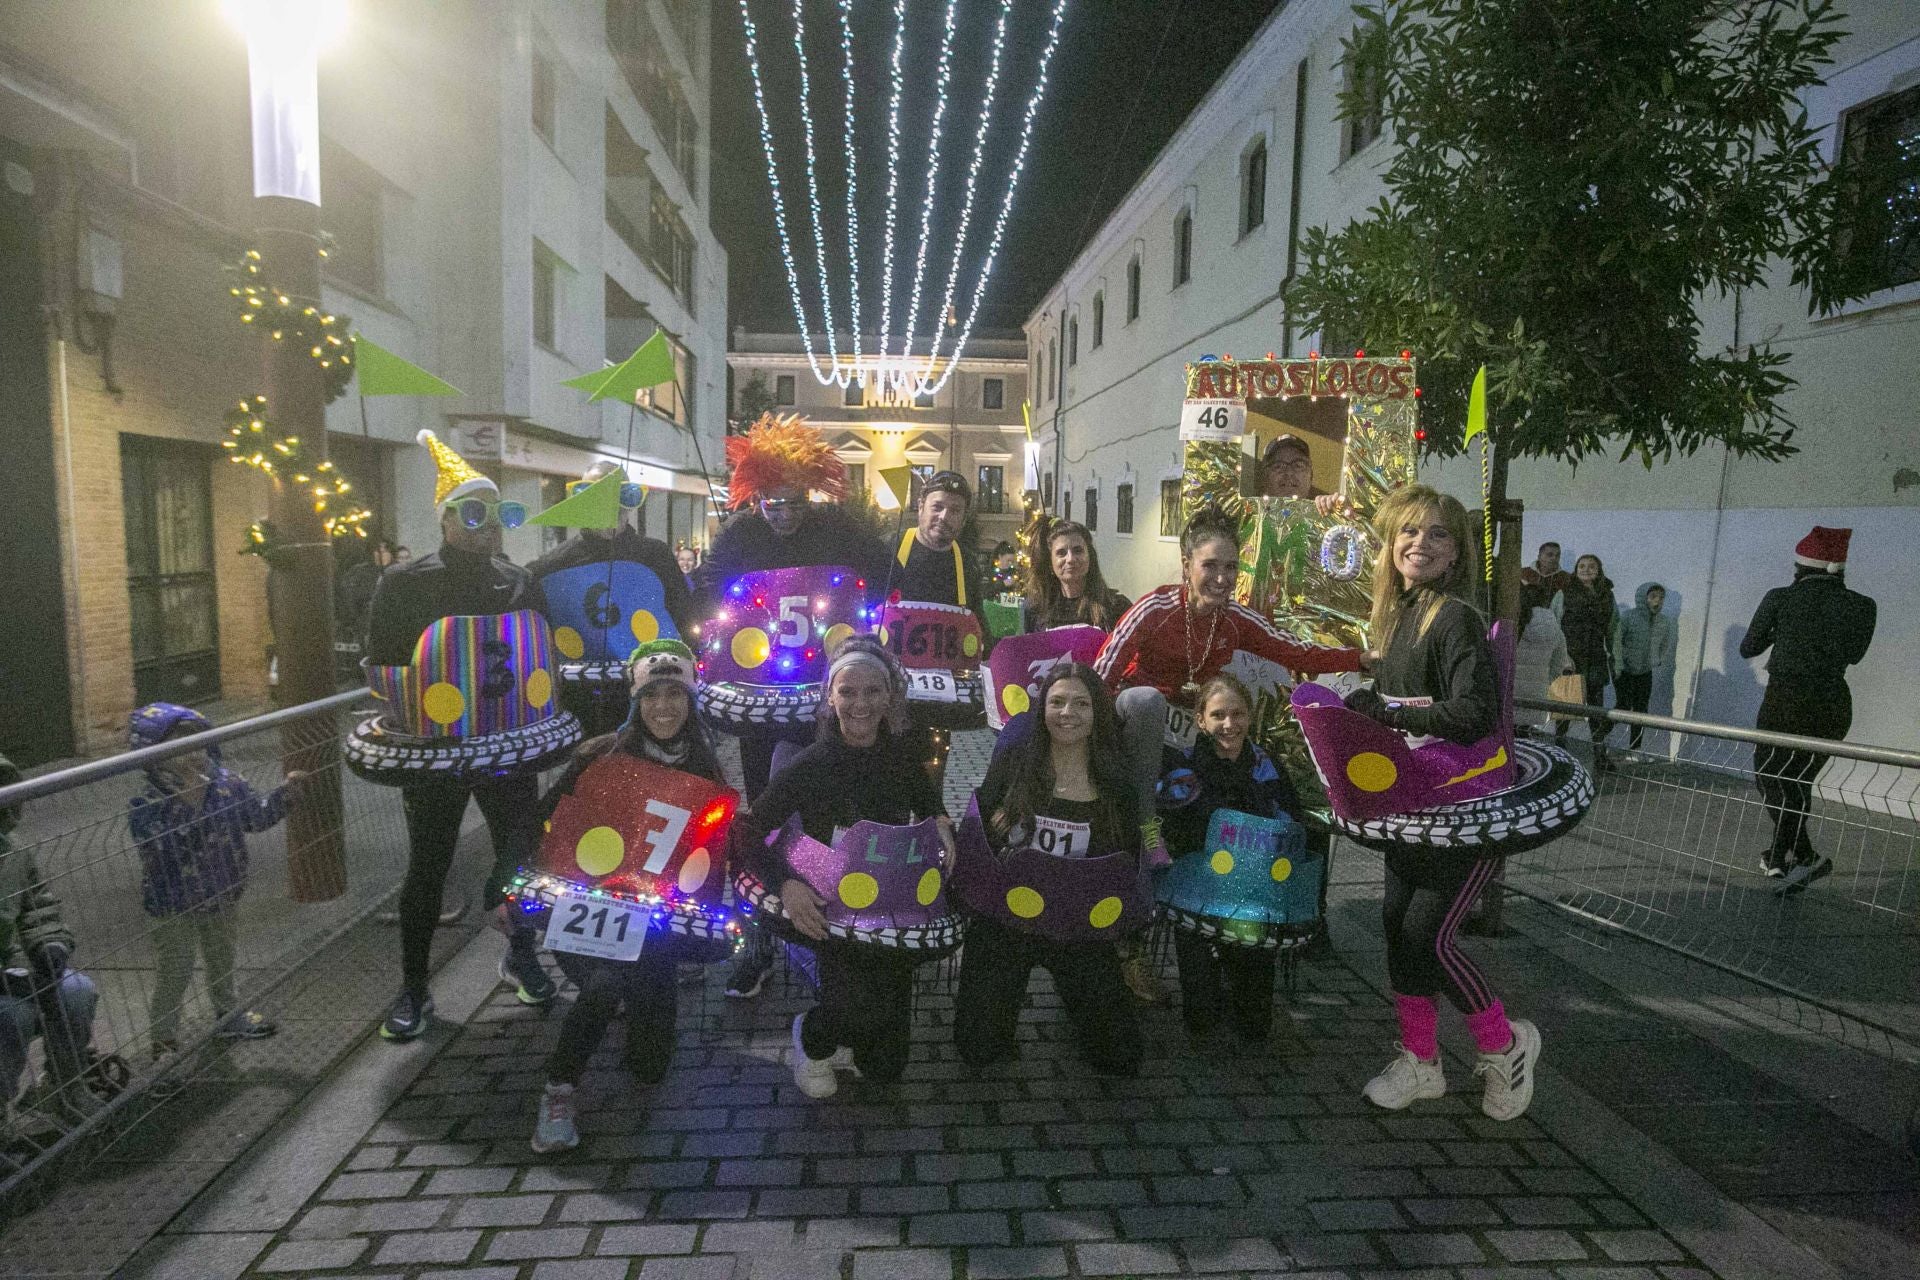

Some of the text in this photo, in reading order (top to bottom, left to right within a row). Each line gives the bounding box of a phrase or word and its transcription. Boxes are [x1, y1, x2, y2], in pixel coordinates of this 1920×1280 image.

[1199, 361, 1413, 399] AUTOS LOCOS
[1197, 406, 1229, 428] 46
[584, 582, 621, 628] 6
[779, 595, 809, 648] 5
[889, 619, 959, 659] 1618
[642, 798, 693, 875] 7
[563, 902, 632, 943] 211
